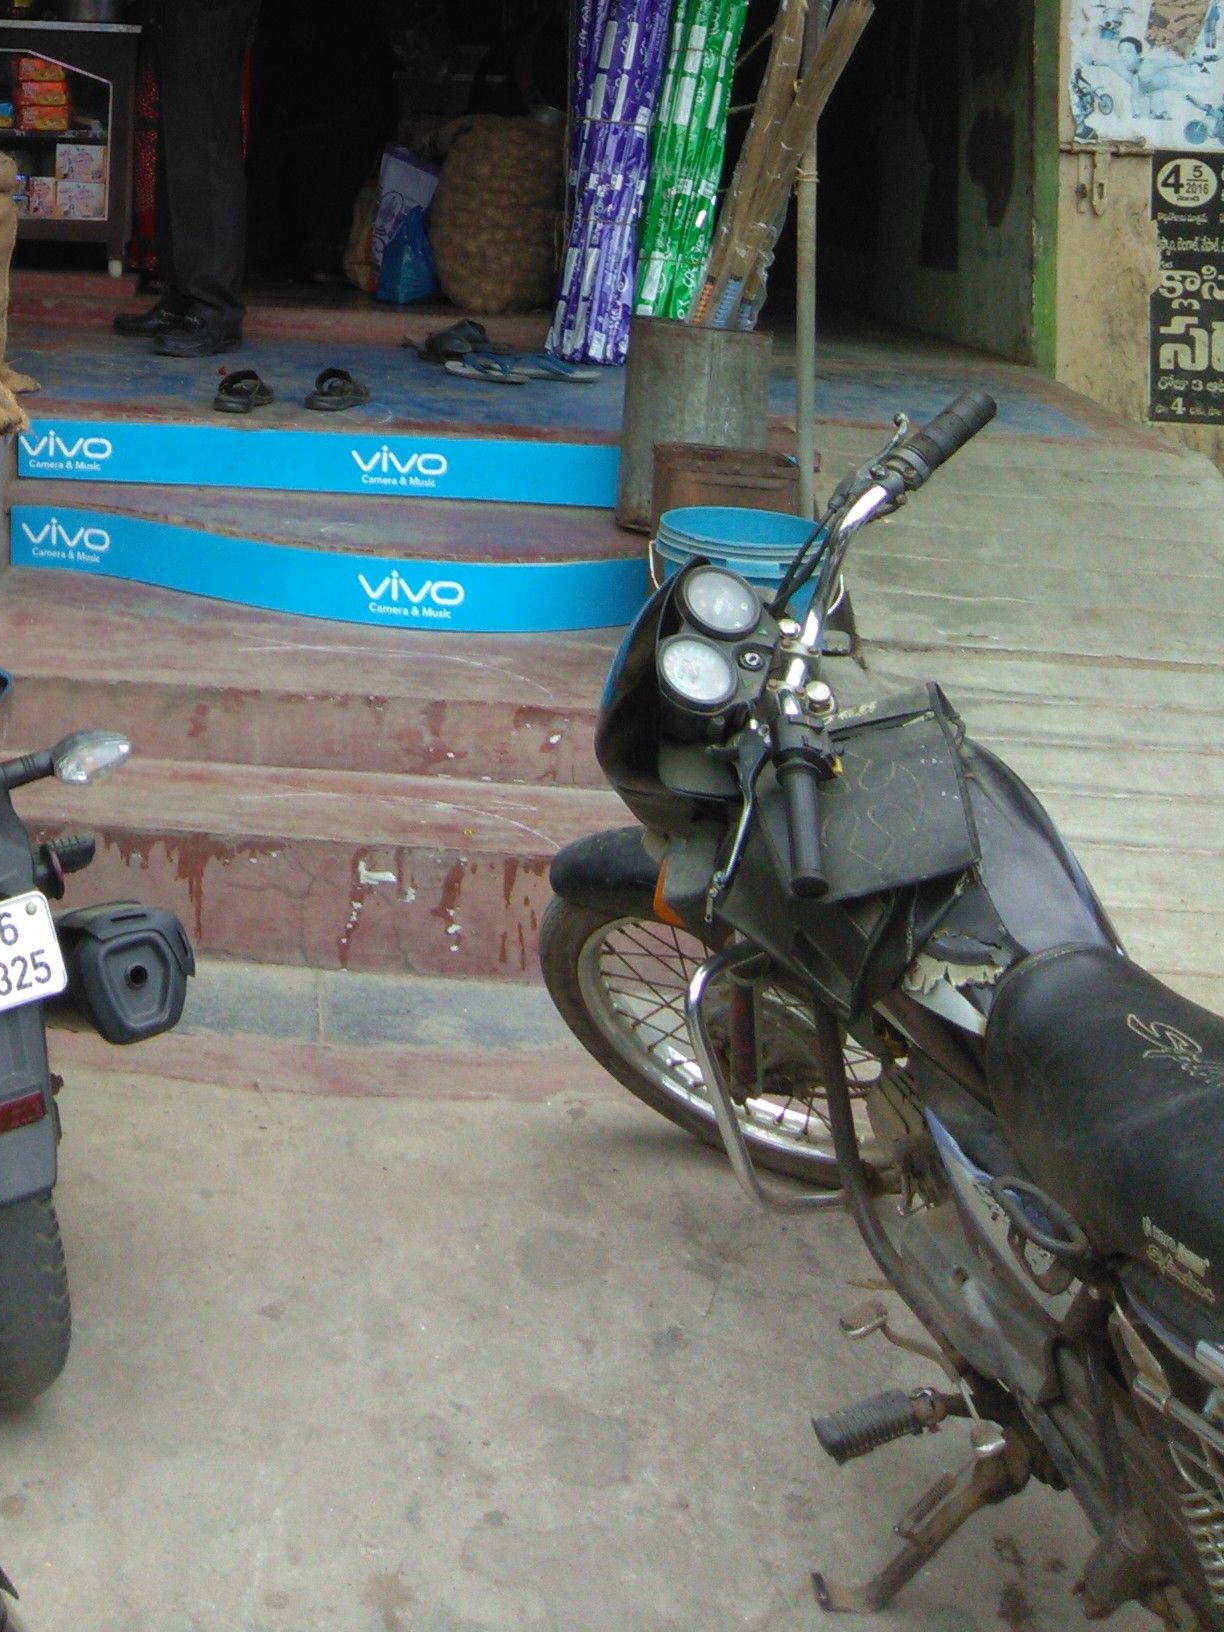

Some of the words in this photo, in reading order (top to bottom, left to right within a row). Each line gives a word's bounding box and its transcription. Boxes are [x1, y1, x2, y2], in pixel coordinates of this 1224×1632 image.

[1184, 181, 1210, 196] 2016
[19, 429, 113, 460] vivo
[28, 459, 63, 472] Camera
[75, 459, 102, 473] Music
[351, 444, 449, 477] vivo
[361, 473, 396, 487] Camera
[409, 475, 437, 489] Music
[21, 517, 111, 554] vivo
[31, 546, 65, 561] Camera
[75, 549, 101, 564] Music
[357, 568, 466, 608] vivo
[368, 602, 409, 617] Camera
[423, 605, 453, 620] Music
